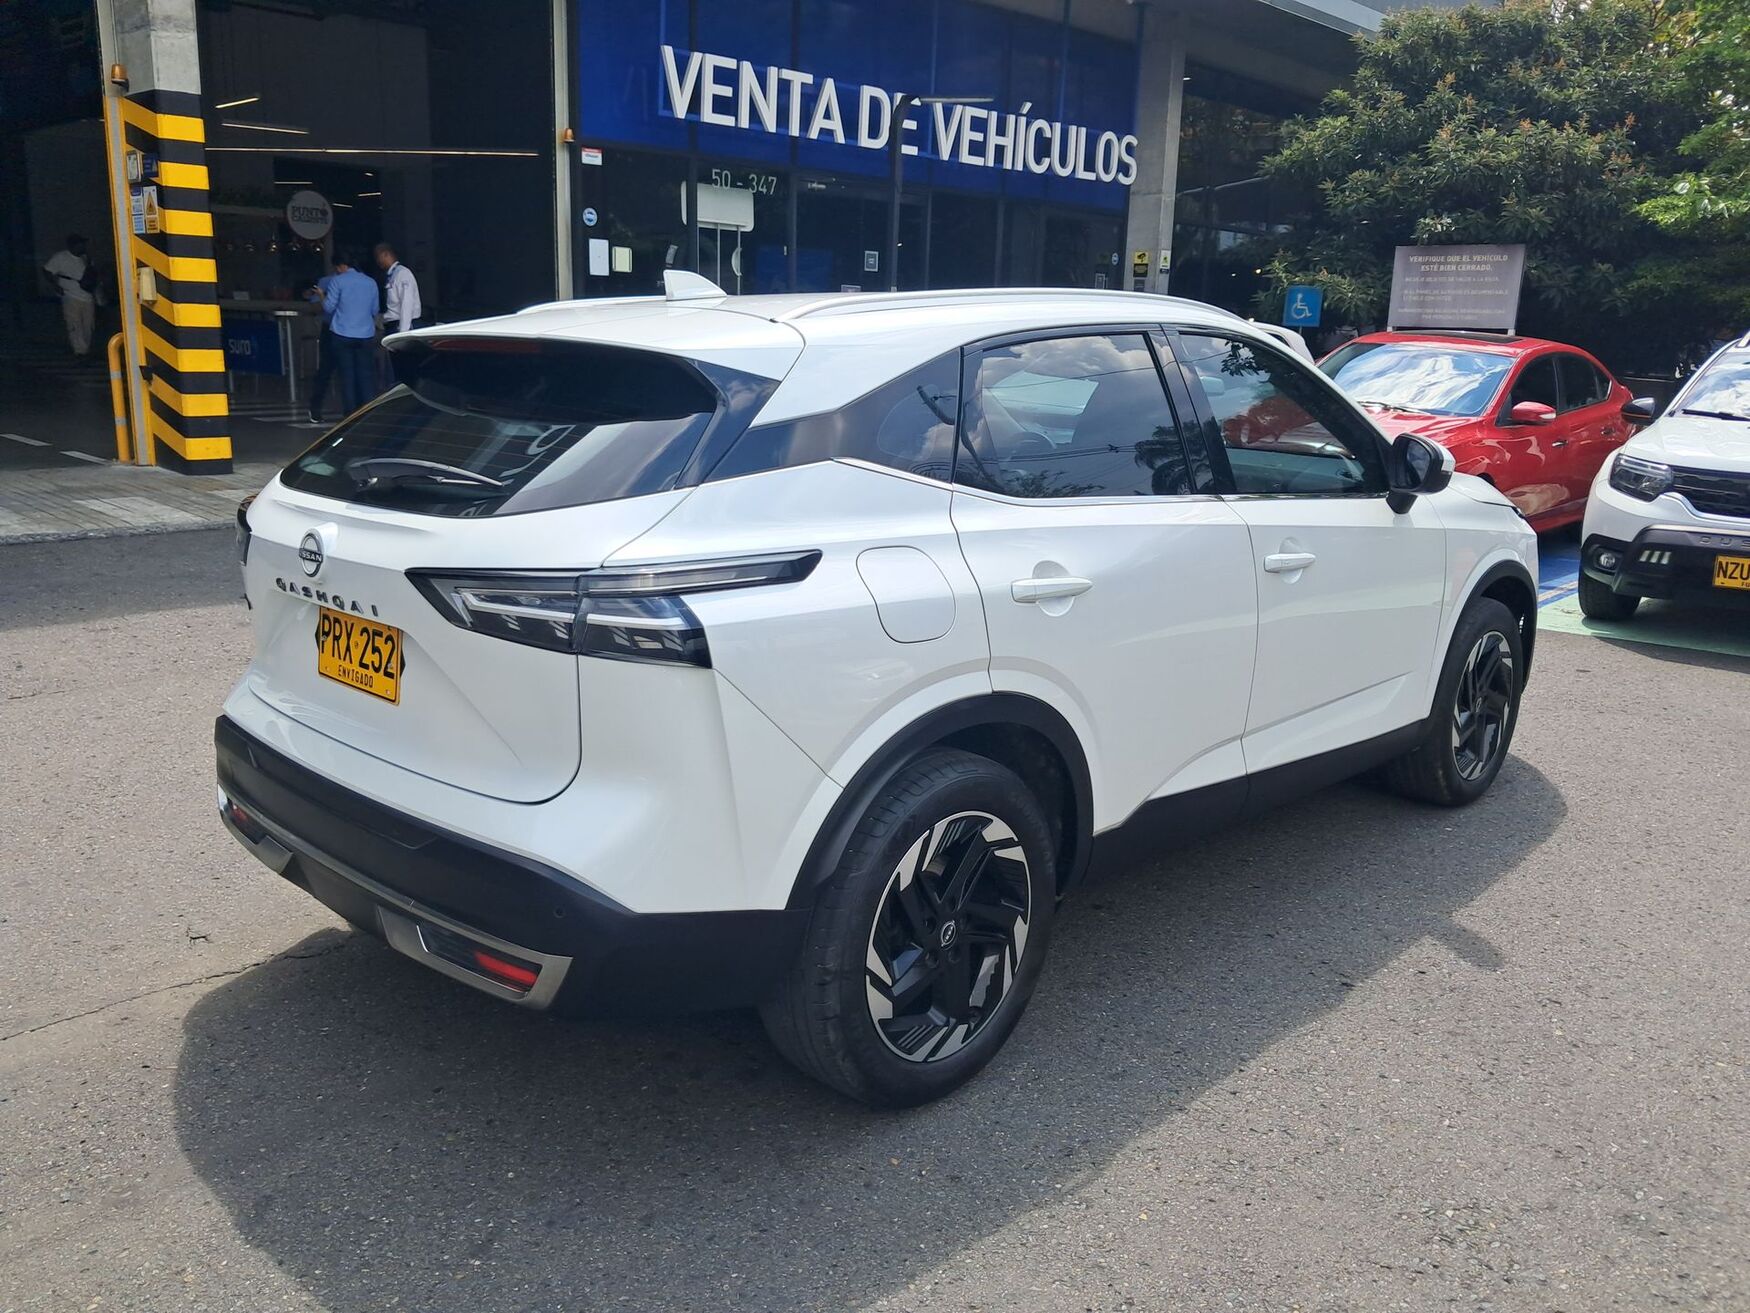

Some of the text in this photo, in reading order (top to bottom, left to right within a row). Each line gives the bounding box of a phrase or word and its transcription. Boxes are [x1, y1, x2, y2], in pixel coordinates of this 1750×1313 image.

[660, 45, 1138, 186] VENTA DE VEHÍCULOS
[711, 168, 731, 190] 50
[749, 174, 777, 196] 347
[1716, 561, 1750, 580] NZU
[275, 577, 379, 617] QASHQAI
[321, 614, 396, 679] PRX 252
[338, 664, 374, 689] ENVIGADO
